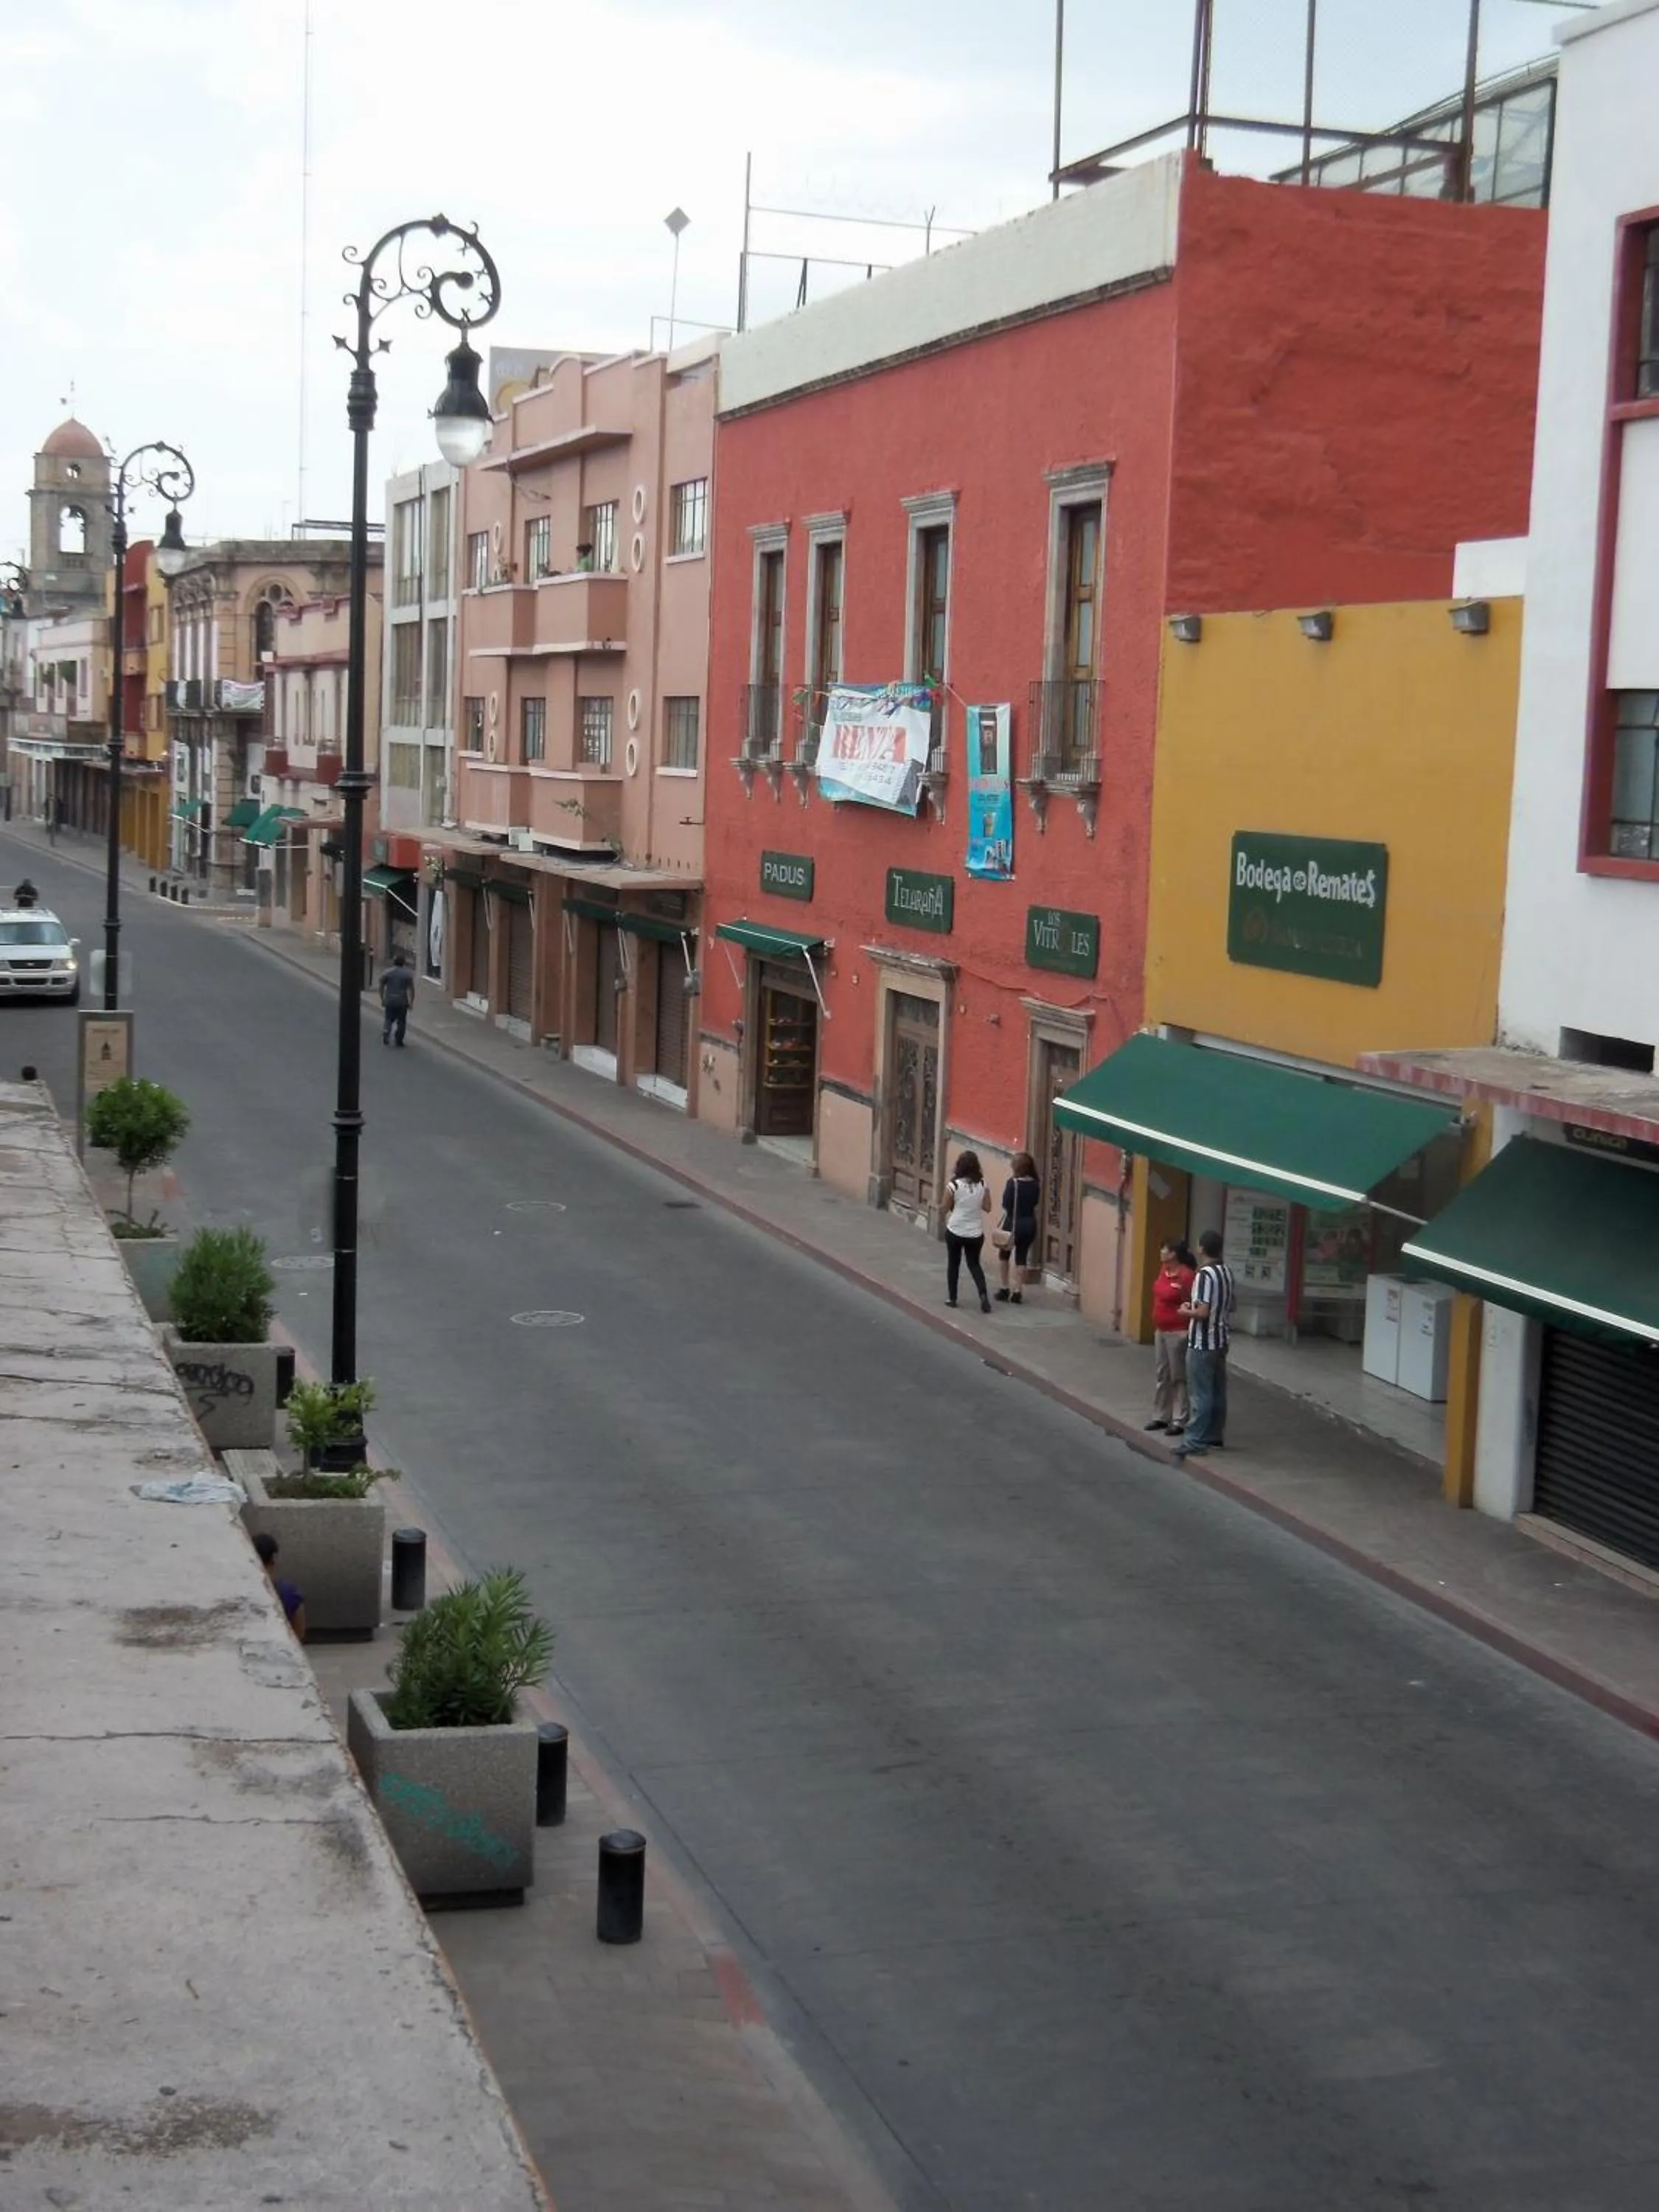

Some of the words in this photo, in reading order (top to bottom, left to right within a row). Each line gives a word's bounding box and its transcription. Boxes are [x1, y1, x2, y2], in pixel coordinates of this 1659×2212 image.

[763, 861, 805, 886] PADUS
[1236, 851, 1291, 904] Bodega
[1047, 910, 1061, 927] LOS
